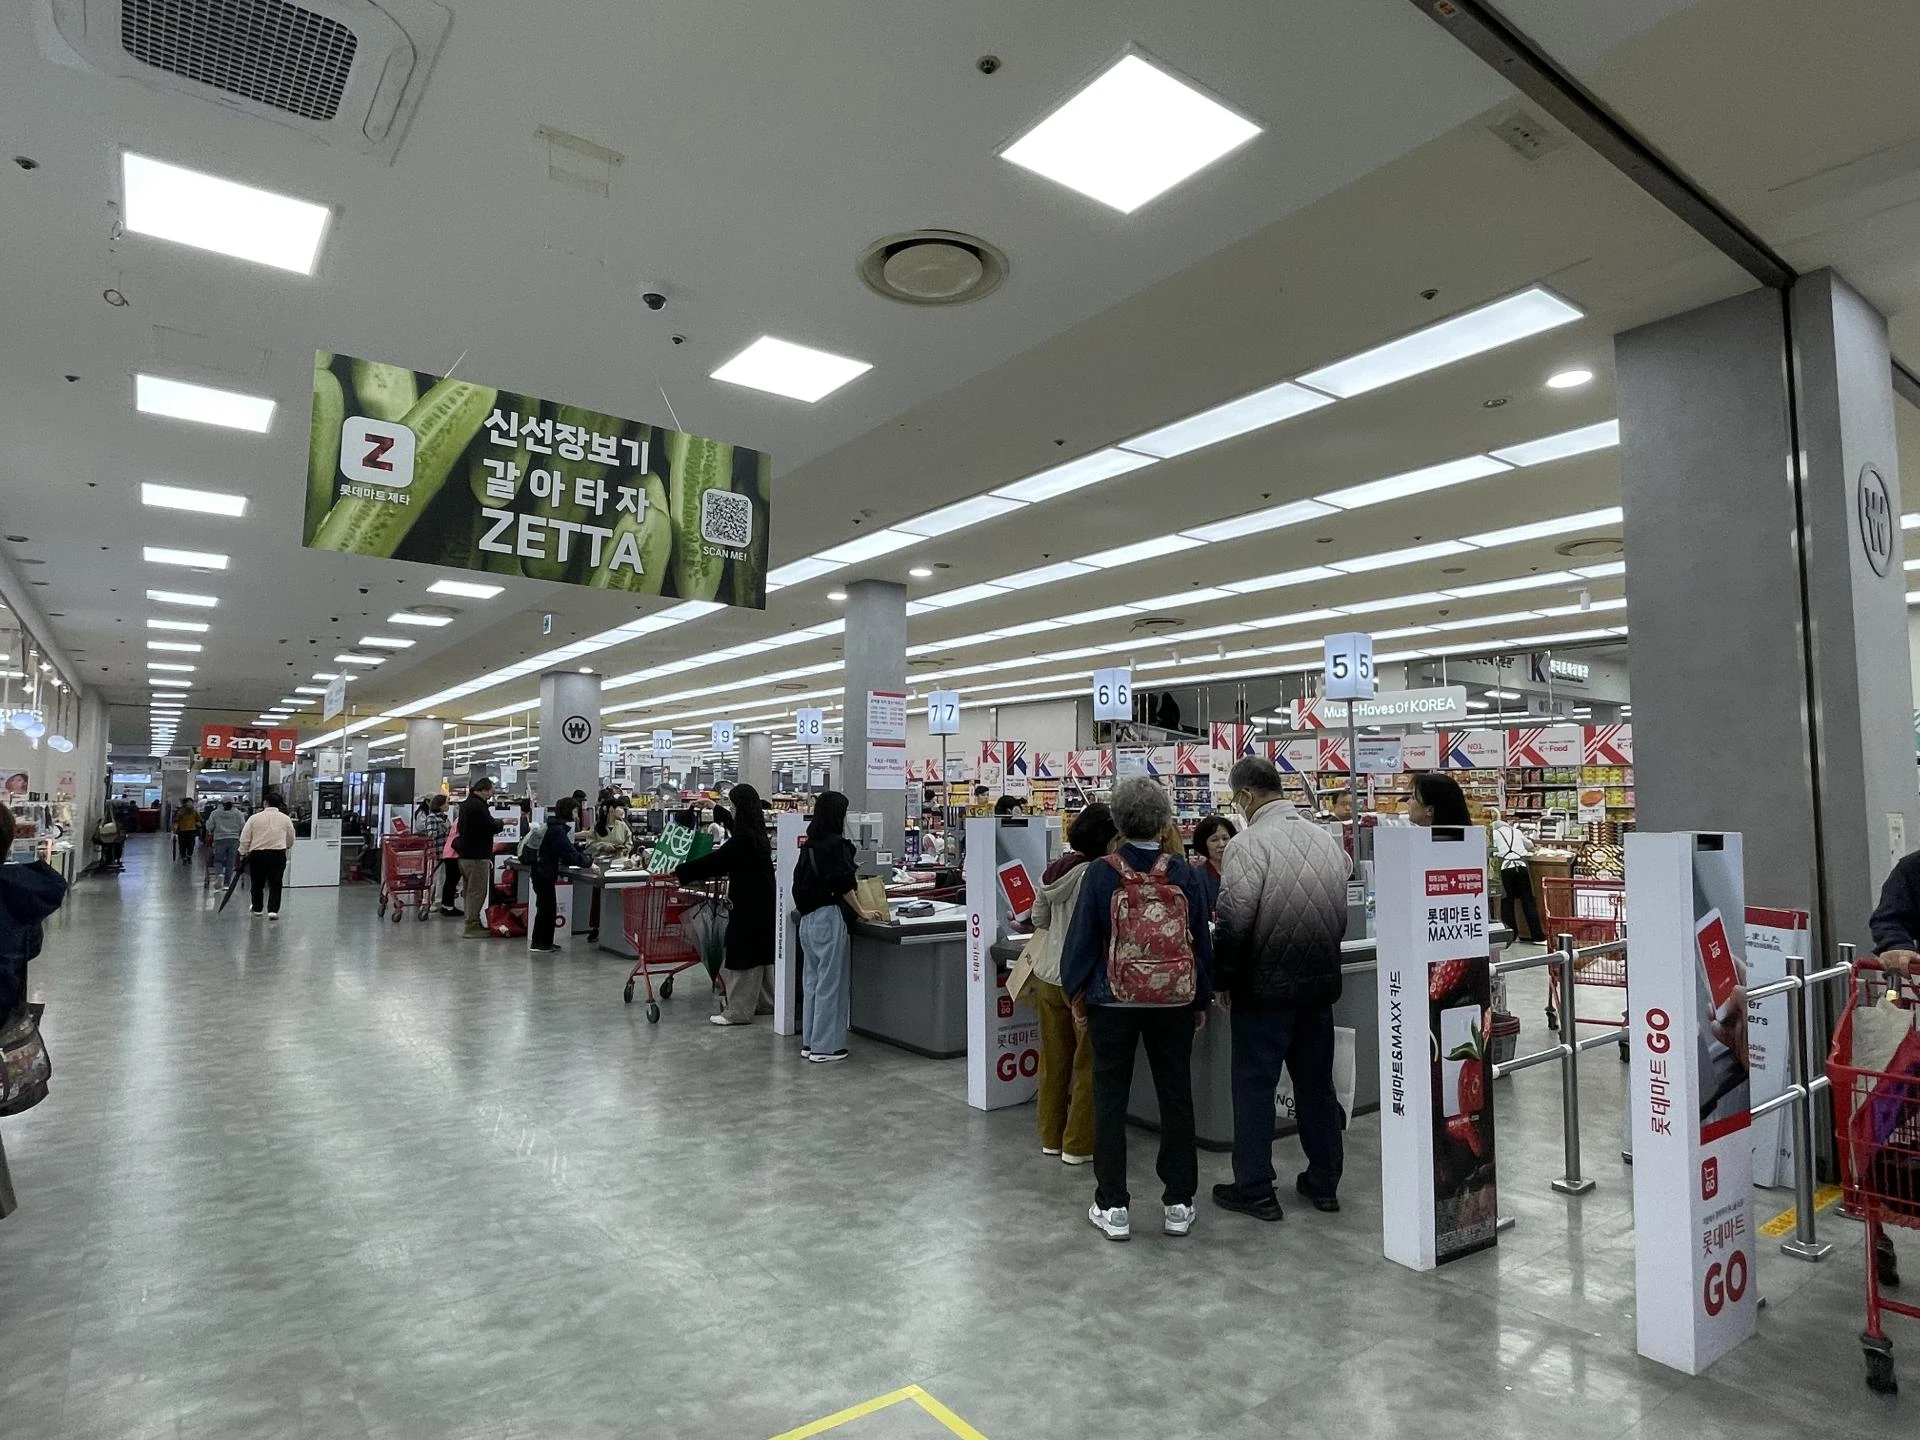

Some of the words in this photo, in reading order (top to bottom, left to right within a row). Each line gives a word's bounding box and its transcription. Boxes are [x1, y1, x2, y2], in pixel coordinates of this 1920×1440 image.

[362, 433, 395, 472] Z
[483, 408, 649, 475] 신선장보기
[339, 483, 386, 501] 롯데마트
[387, 490, 411, 506] 제타
[478, 507, 645, 575] ZETTA
[703, 547, 729, 559] SCAN
[730, 550, 747, 562] ME!
[1332, 654, 1349, 679] 5
[1359, 654, 1369, 679] 5
[1099, 685, 1109, 705] 6
[1117, 684, 1128, 704] 6
[930, 704, 939, 722] 7
[945, 703, 955, 721] 7
[1324, 703, 1395, 719] Mus-Haves
[1410, 697, 1456, 712] KOREA
[721, 730, 730, 743] 9
[799, 720, 805, 734] 8
[810, 720, 819, 734] 8
[226, 736, 272, 751] ZETTA
[659, 738, 672, 750] 10
[972, 913, 980, 938] GO
[1427, 906, 1470, 925] 롯데마트
[1474, 905, 1482, 920] &
[1390, 971, 1402, 997] 카드
[998, 1030, 1040, 1048] 롯데마트
[1646, 1008, 1670, 1054] GO
[997, 1048, 1040, 1082] GO
[1650, 1059, 1671, 1136] 롯데마트
[1703, 1214, 1745, 1258] 롯데마트
[1703, 1250, 1747, 1317] GO
